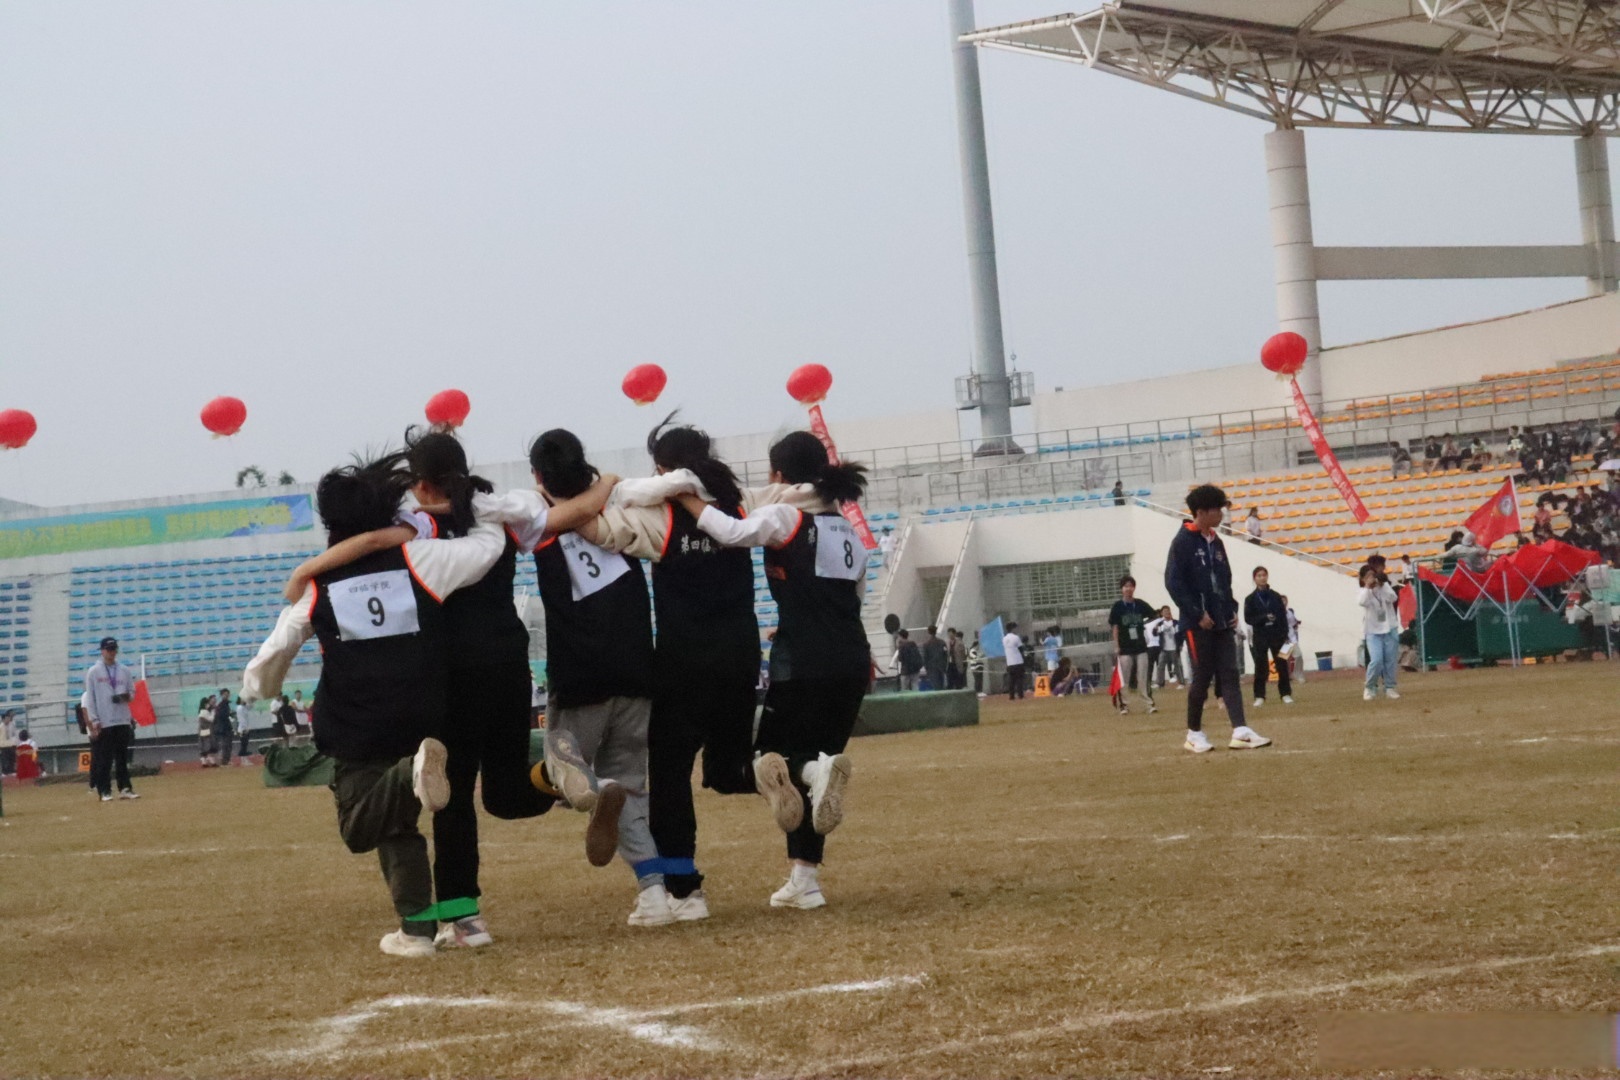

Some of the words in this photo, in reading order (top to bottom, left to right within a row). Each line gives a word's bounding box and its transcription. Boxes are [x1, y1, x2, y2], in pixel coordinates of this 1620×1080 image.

[578, 550, 601, 579] 3
[843, 539, 854, 569] 8
[367, 596, 385, 627] 9
[1037, 678, 1047, 691] 4
[81, 754, 91, 766] 8
